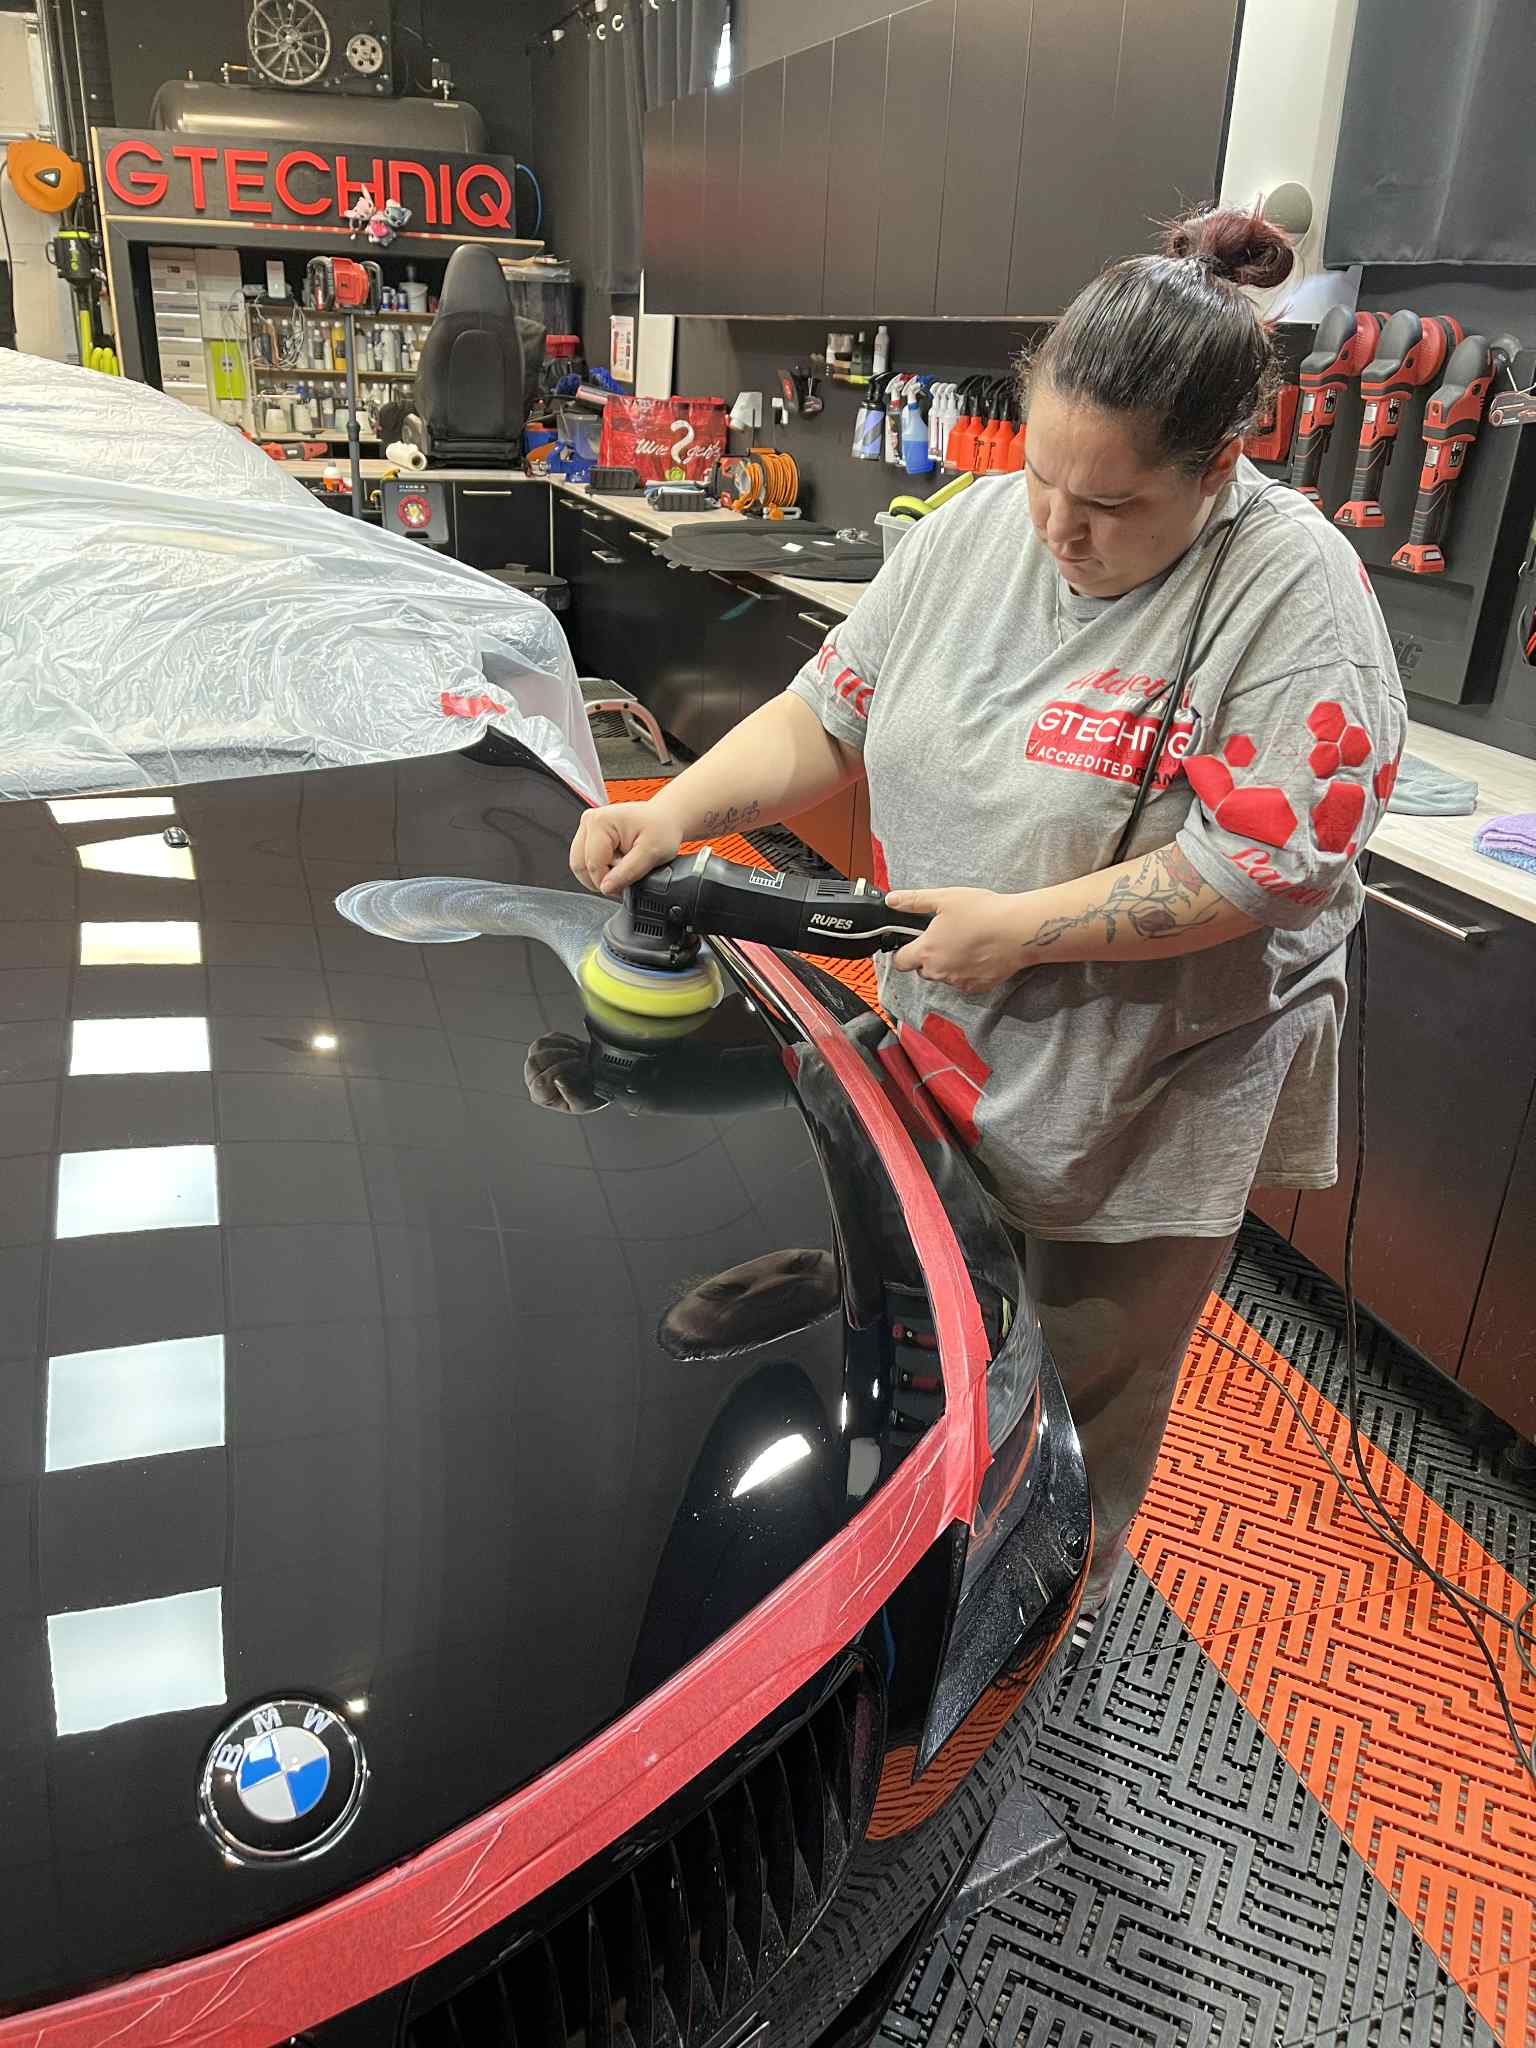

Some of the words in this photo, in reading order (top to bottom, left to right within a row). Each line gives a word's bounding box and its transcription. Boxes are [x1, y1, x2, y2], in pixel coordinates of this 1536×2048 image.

[105, 140, 512, 229] GTECHNIQ
[1036, 744, 1133, 778] ACCREDITED
[810, 912, 853, 931] RUPES
[215, 1706, 335, 1772] BMW
